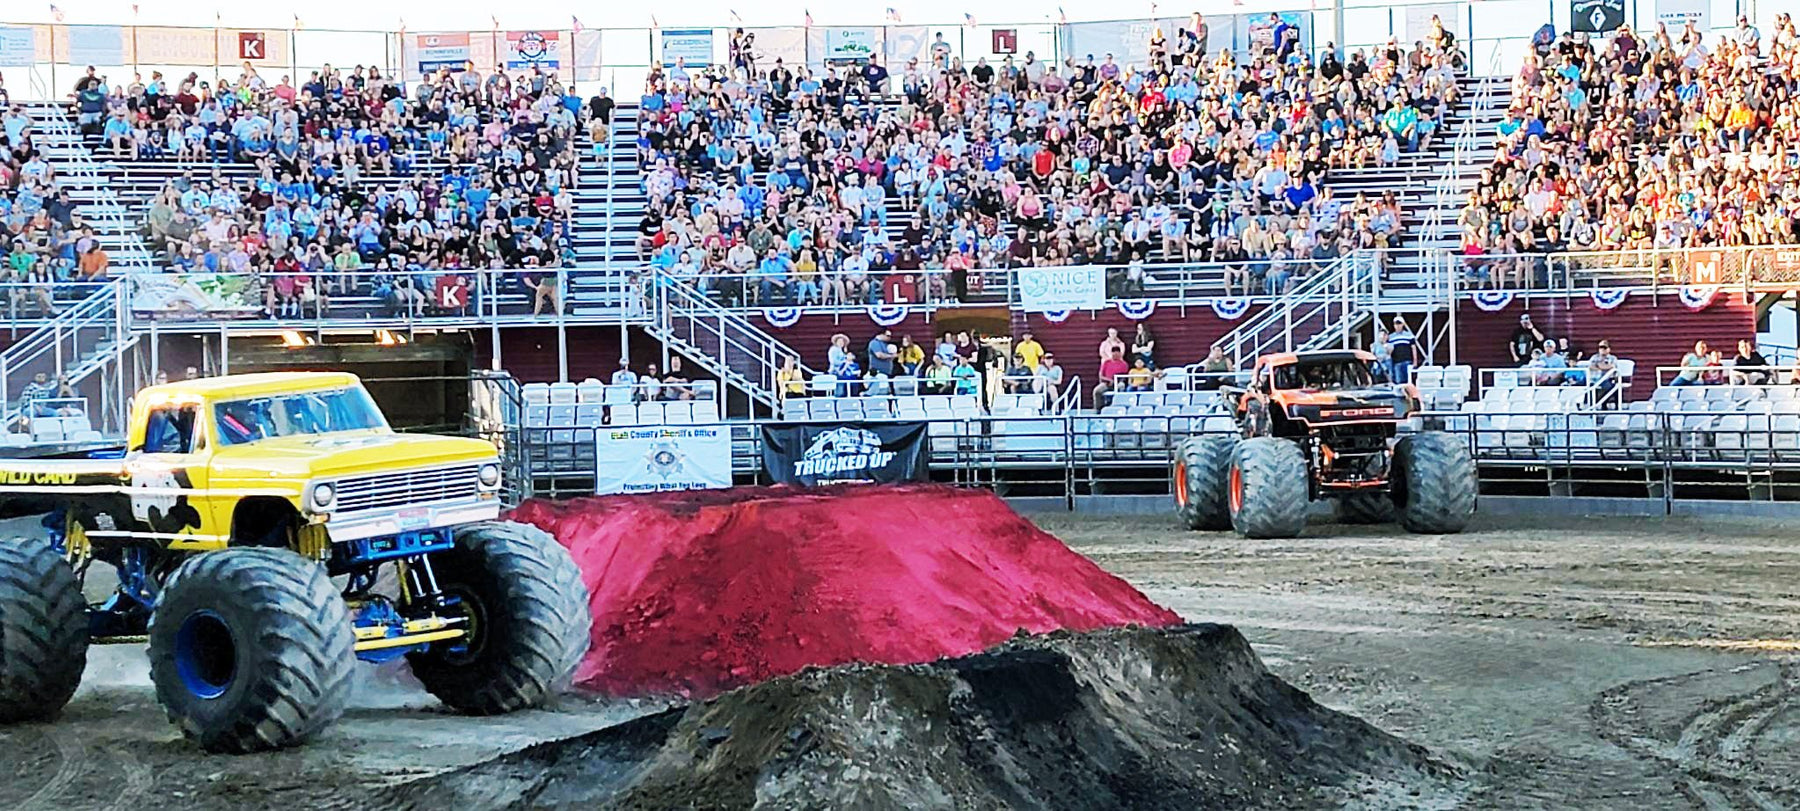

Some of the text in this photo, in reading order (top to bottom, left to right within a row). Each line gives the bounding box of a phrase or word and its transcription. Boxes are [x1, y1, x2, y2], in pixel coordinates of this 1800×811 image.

[244, 39, 260, 57] K
[998, 36, 1012, 53] L
[1776, 251, 1799, 262] EXIT
[1052, 270, 1097, 285] NICE
[1695, 261, 1716, 282] M
[442, 285, 460, 306] K
[893, 283, 908, 303] L
[1320, 407, 1394, 417] FORD
[630, 430, 658, 439] County
[694, 429, 717, 437] Office
[794, 451, 894, 477] TRUCKED UP
[33, 471, 77, 485] CARD
